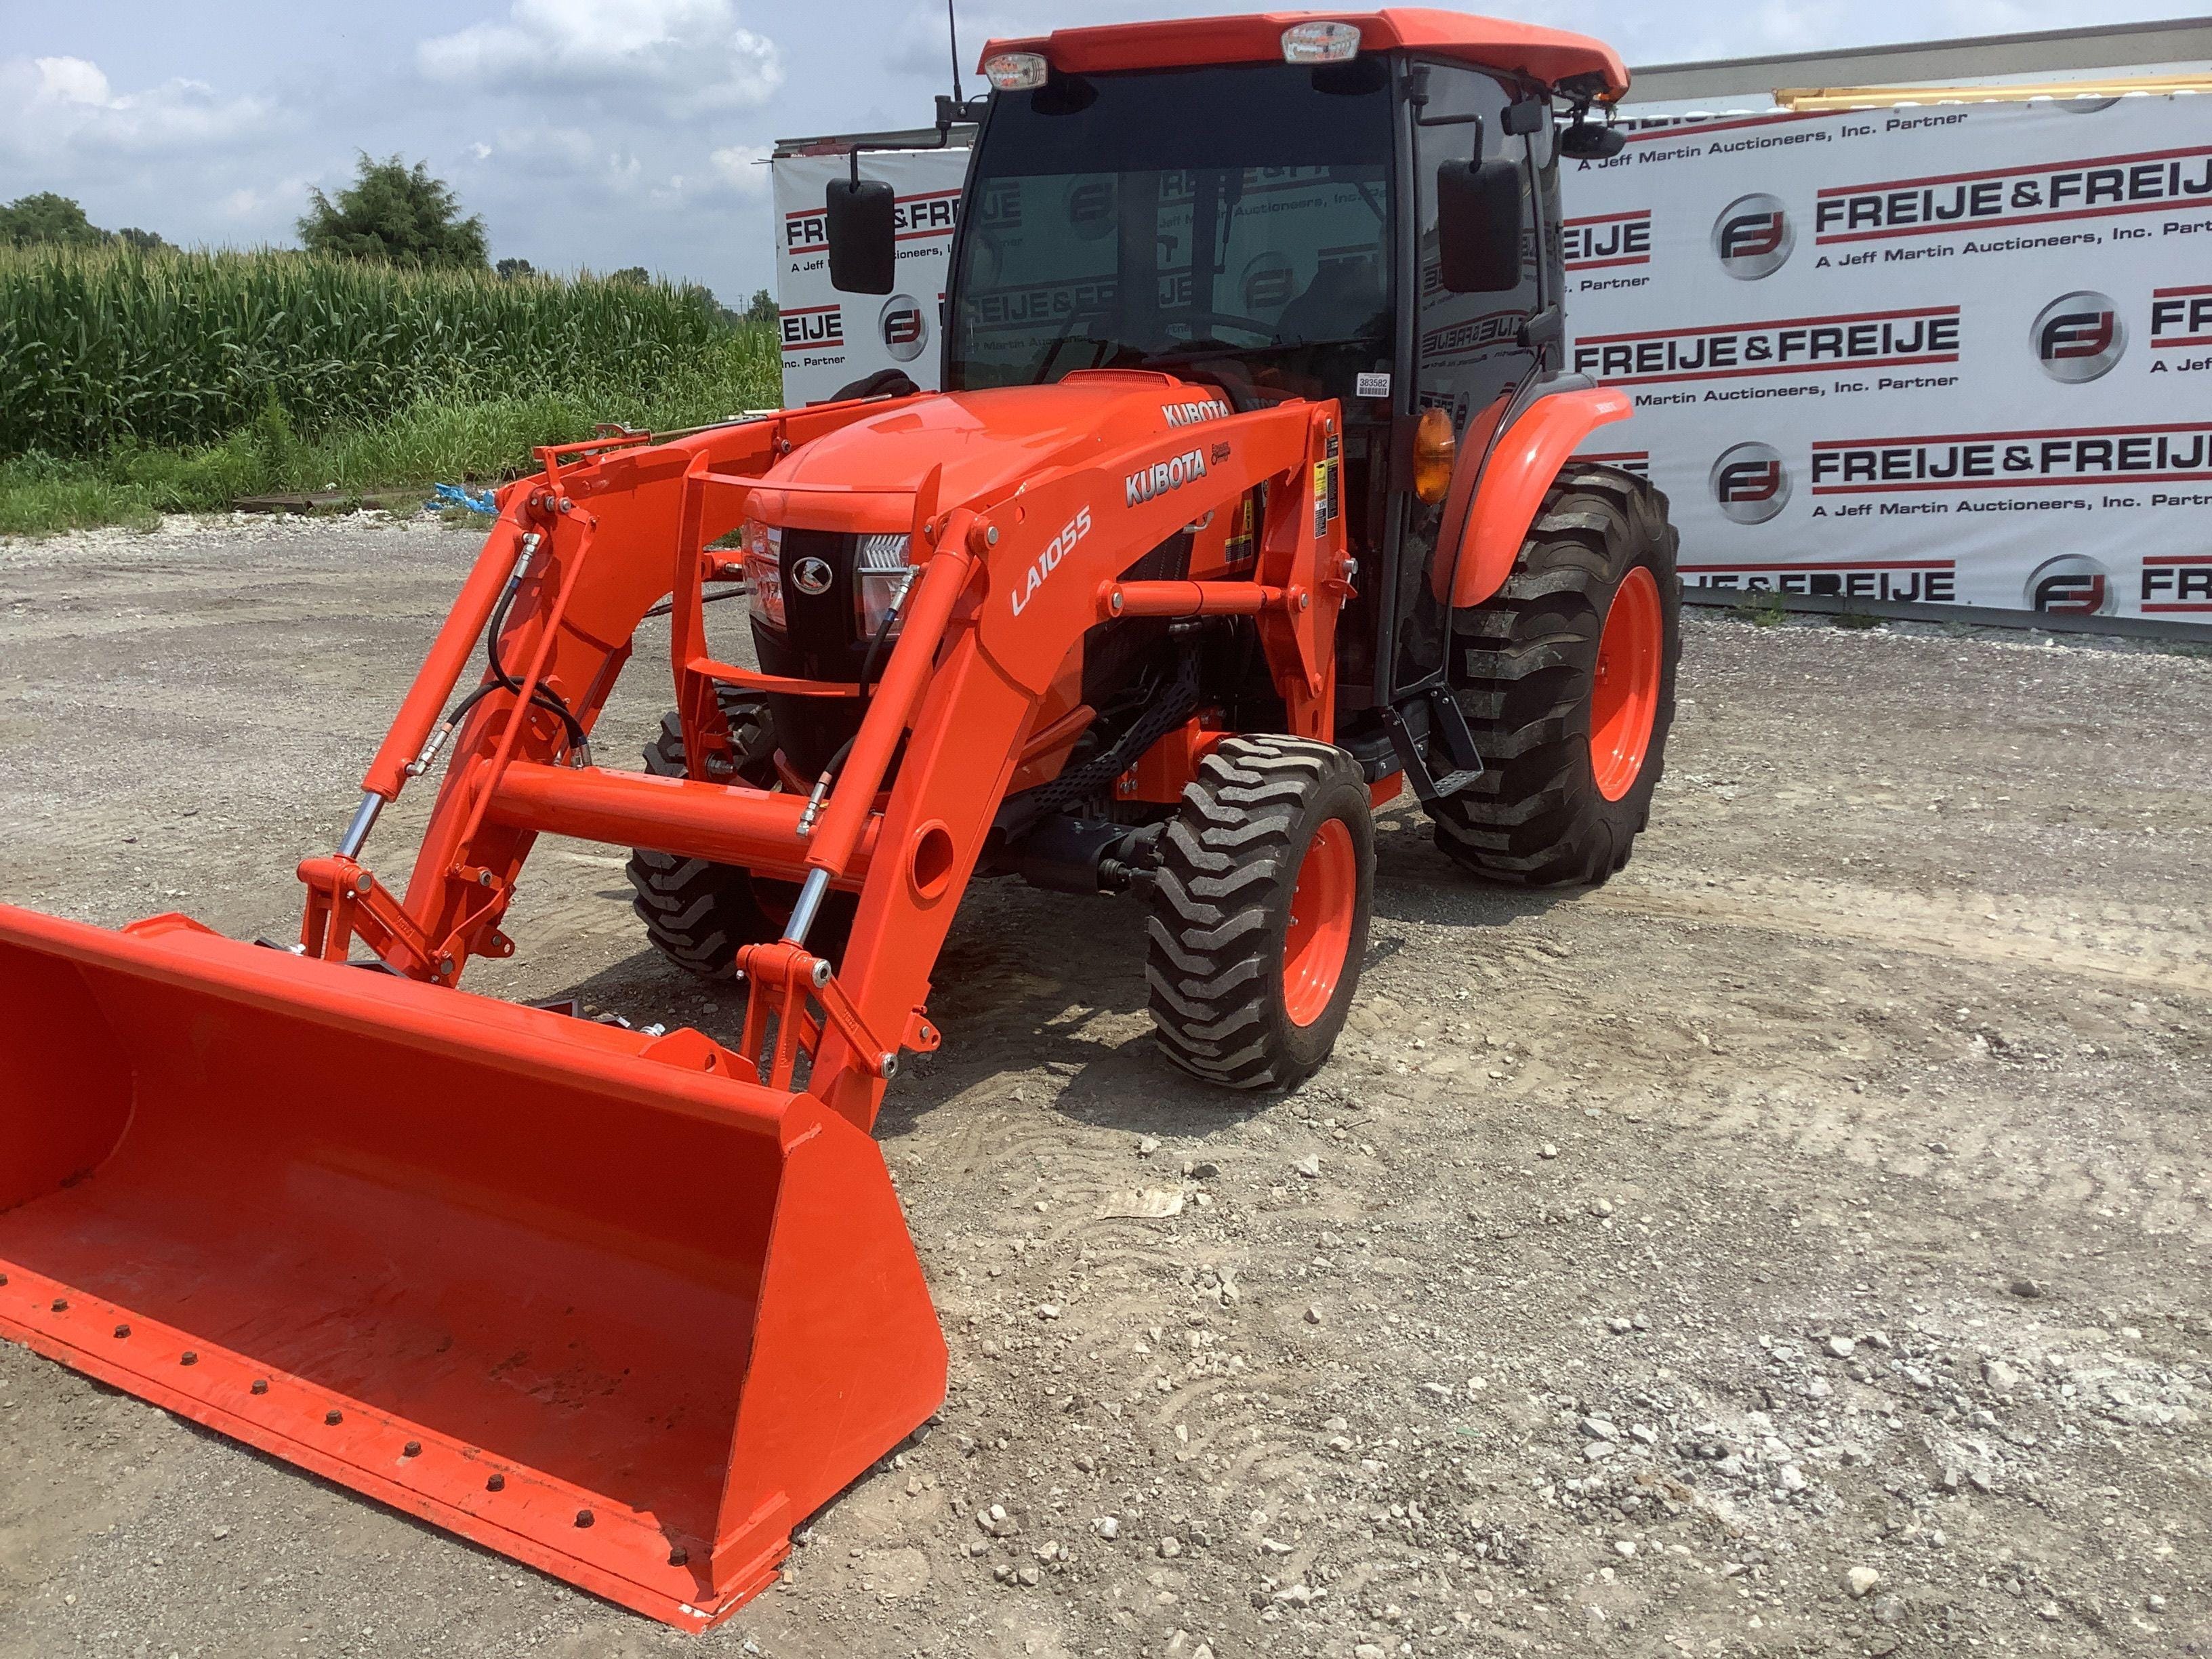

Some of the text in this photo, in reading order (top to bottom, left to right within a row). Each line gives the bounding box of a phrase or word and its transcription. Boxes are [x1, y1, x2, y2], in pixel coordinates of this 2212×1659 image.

[1577, 112, 1969, 171] A Jeff Martin Auctioneers, Inc. Partner
[1816, 181, 2003, 232] FREIJE
[2011, 180, 2043, 207] &
[1815, 256, 1831, 268] A
[1838, 251, 1878, 268] Jeff
[1884, 244, 1955, 262] Martin
[1962, 230, 2103, 255] Auctioneers,
[2112, 227, 2152, 241] Inc.
[791, 260, 824, 272] A Jeff
[1580, 276, 1651, 292] Partner
[781, 313, 843, 342] EIJE
[1574, 336, 1738, 375] FREIJE
[1744, 335, 1773, 360] &
[1779, 317, 1960, 362] FREIJE
[804, 356, 846, 367] Partner
[2150, 361, 2168, 373] A
[1359, 378, 1387, 387] 383582
[1634, 375, 1959, 407] Martin Auctioneers, Inc. Partner
[1161, 400, 1230, 429] KUBOTA
[1811, 434, 2212, 483] FREIJE & FREIJ
[1126, 449, 1206, 508] KUBOTA
[1811, 506, 1828, 517] A
[1834, 504, 1872, 516] Jeff
[1879, 501, 1948, 516] Martin
[1956, 496, 2093, 514] Auctioneers,
[2102, 495, 2142, 508] Inc.
[1010, 505, 1092, 617] LA1055
